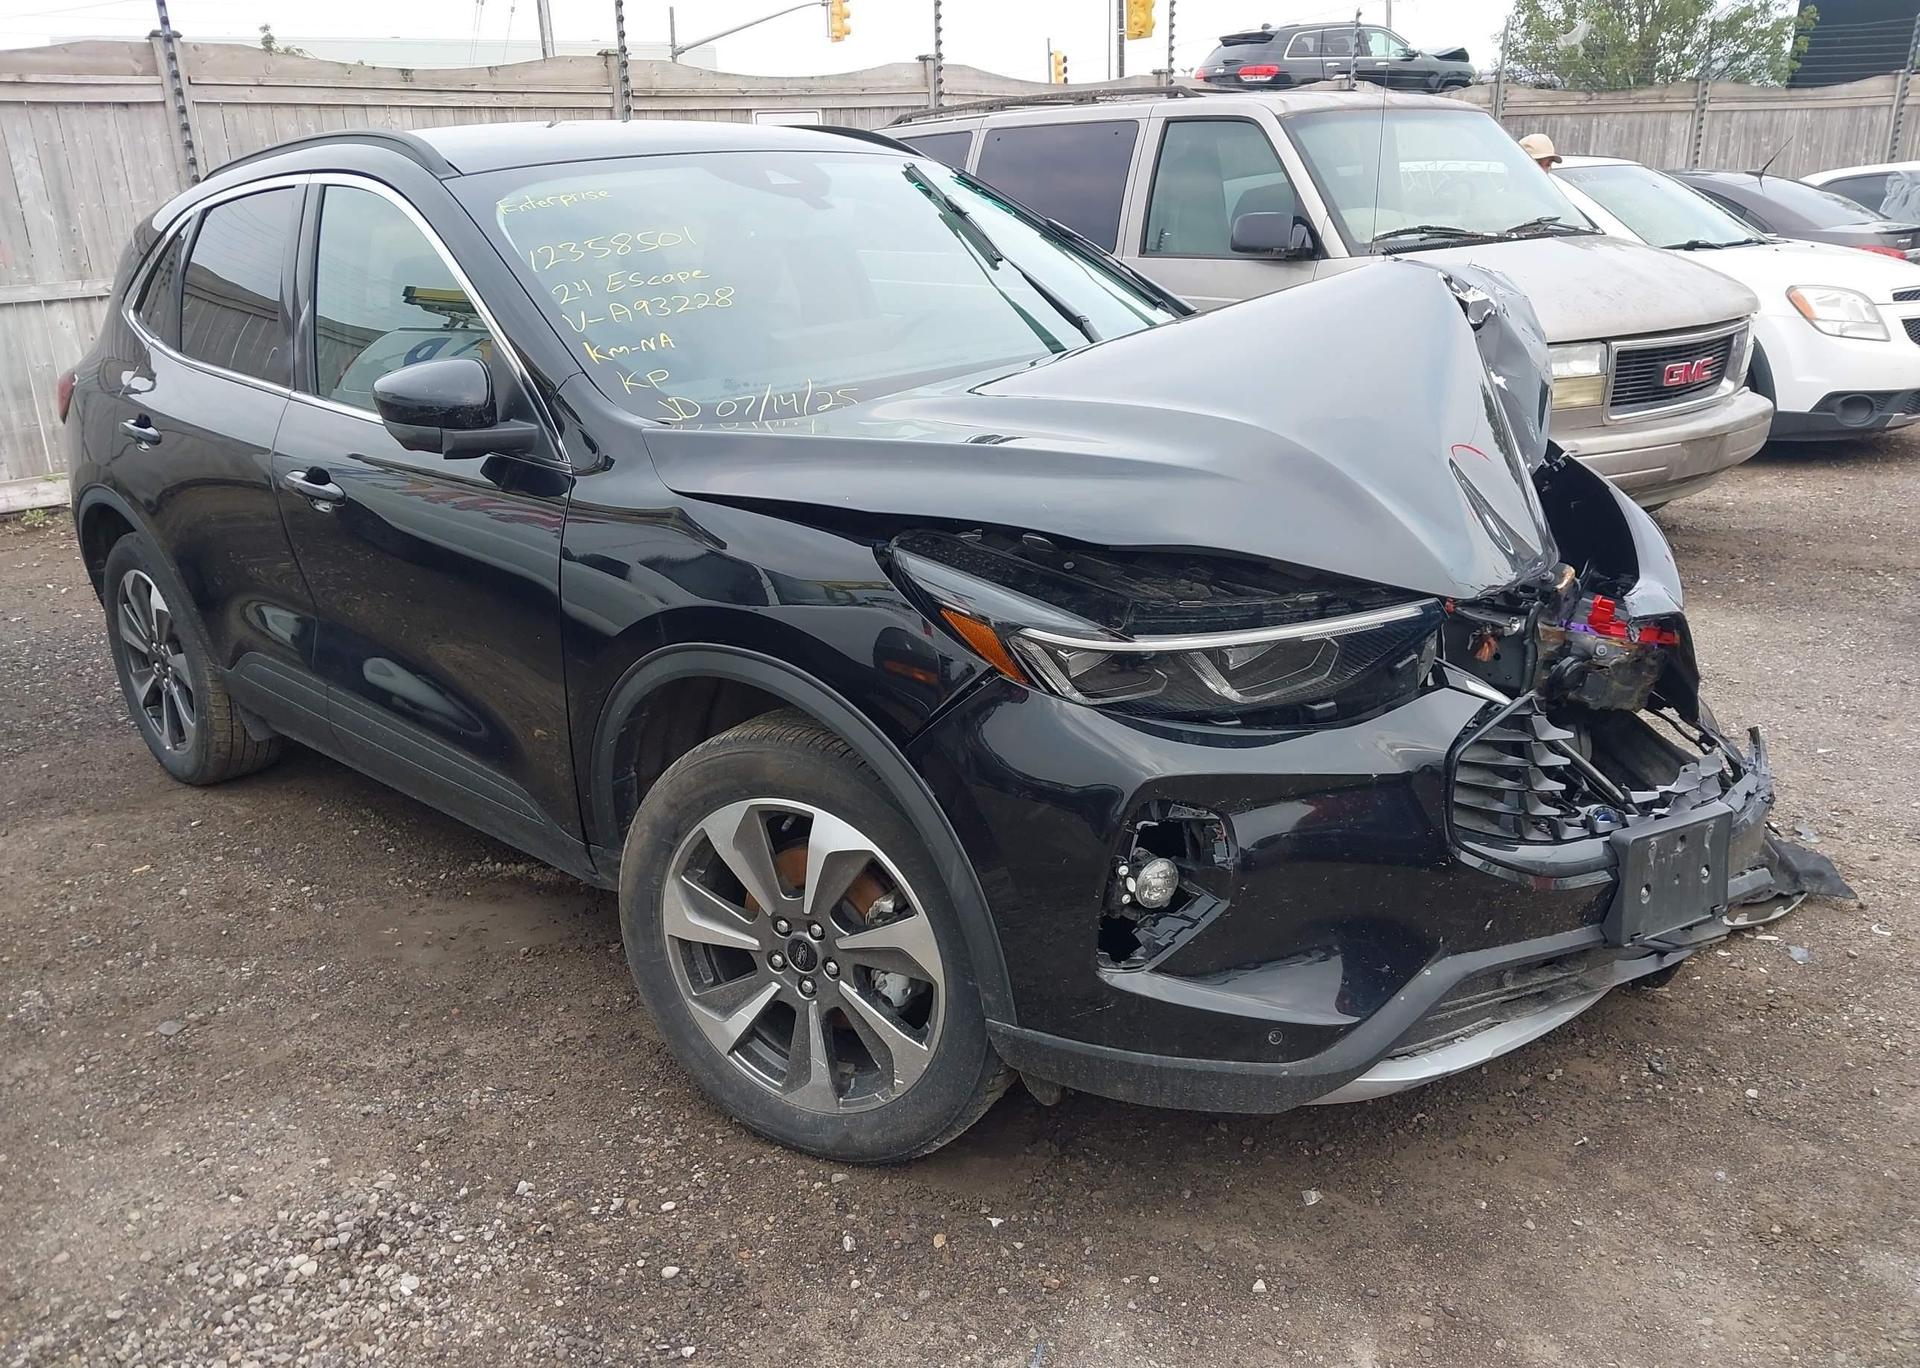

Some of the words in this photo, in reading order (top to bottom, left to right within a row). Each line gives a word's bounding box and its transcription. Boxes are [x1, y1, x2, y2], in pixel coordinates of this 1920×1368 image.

[499, 189, 612, 215] Enterprise
[528, 226, 697, 273] 12358501
[551, 279, 593, 305] 24
[561, 286, 735, 333] V-A93228
[615, 369, 670, 395] KP
[1664, 357, 1713, 387] GMC
[715, 378, 859, 422] 07/14/25
